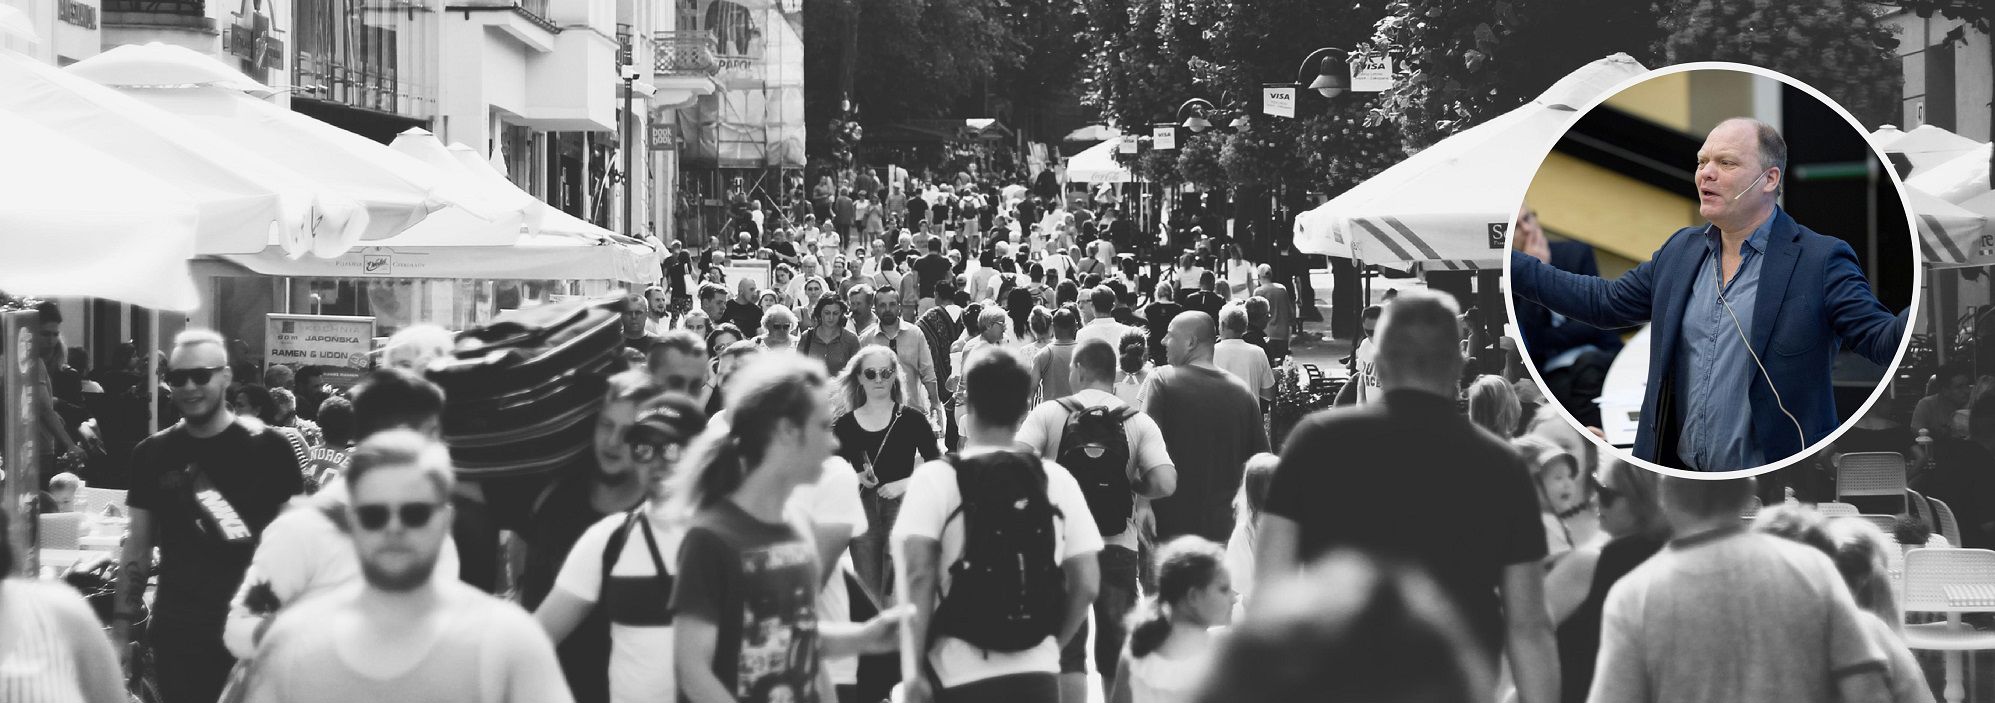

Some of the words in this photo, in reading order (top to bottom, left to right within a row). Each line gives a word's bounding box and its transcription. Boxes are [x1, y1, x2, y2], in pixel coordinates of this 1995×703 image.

[652, 127, 672, 137] book
[271, 348, 307, 358] RAMEN
[310, 350, 317, 358] &
[320, 351, 349, 359] UDON
